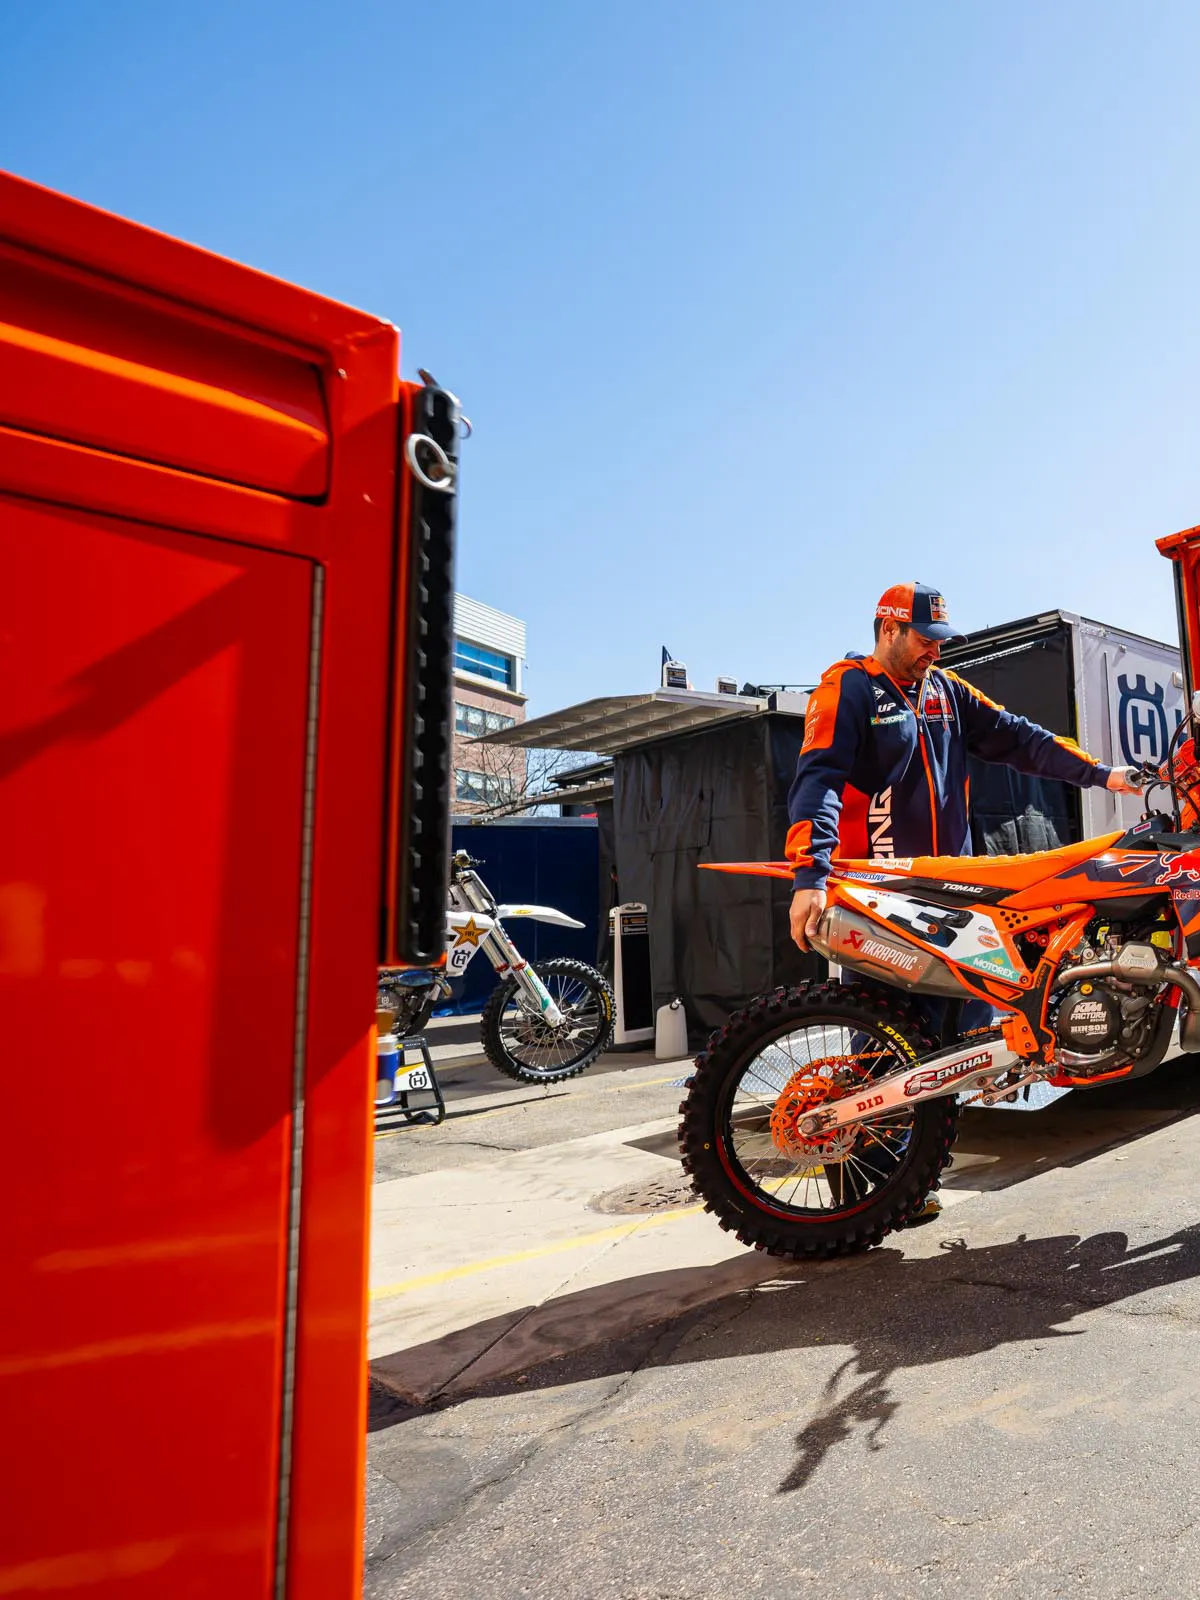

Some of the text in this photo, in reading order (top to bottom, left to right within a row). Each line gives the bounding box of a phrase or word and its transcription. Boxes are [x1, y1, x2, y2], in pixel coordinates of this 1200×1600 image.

[941, 883, 984, 894] TOMAC
[1173, 889, 1194, 900] Red
[973, 957, 1015, 979] MOTOREX
[1073, 1001, 1103, 1014] KTM
[1070, 1011, 1107, 1021] FACTORY
[1070, 1023, 1108, 1035] HINSON
[856, 1095, 885, 1113] DID
